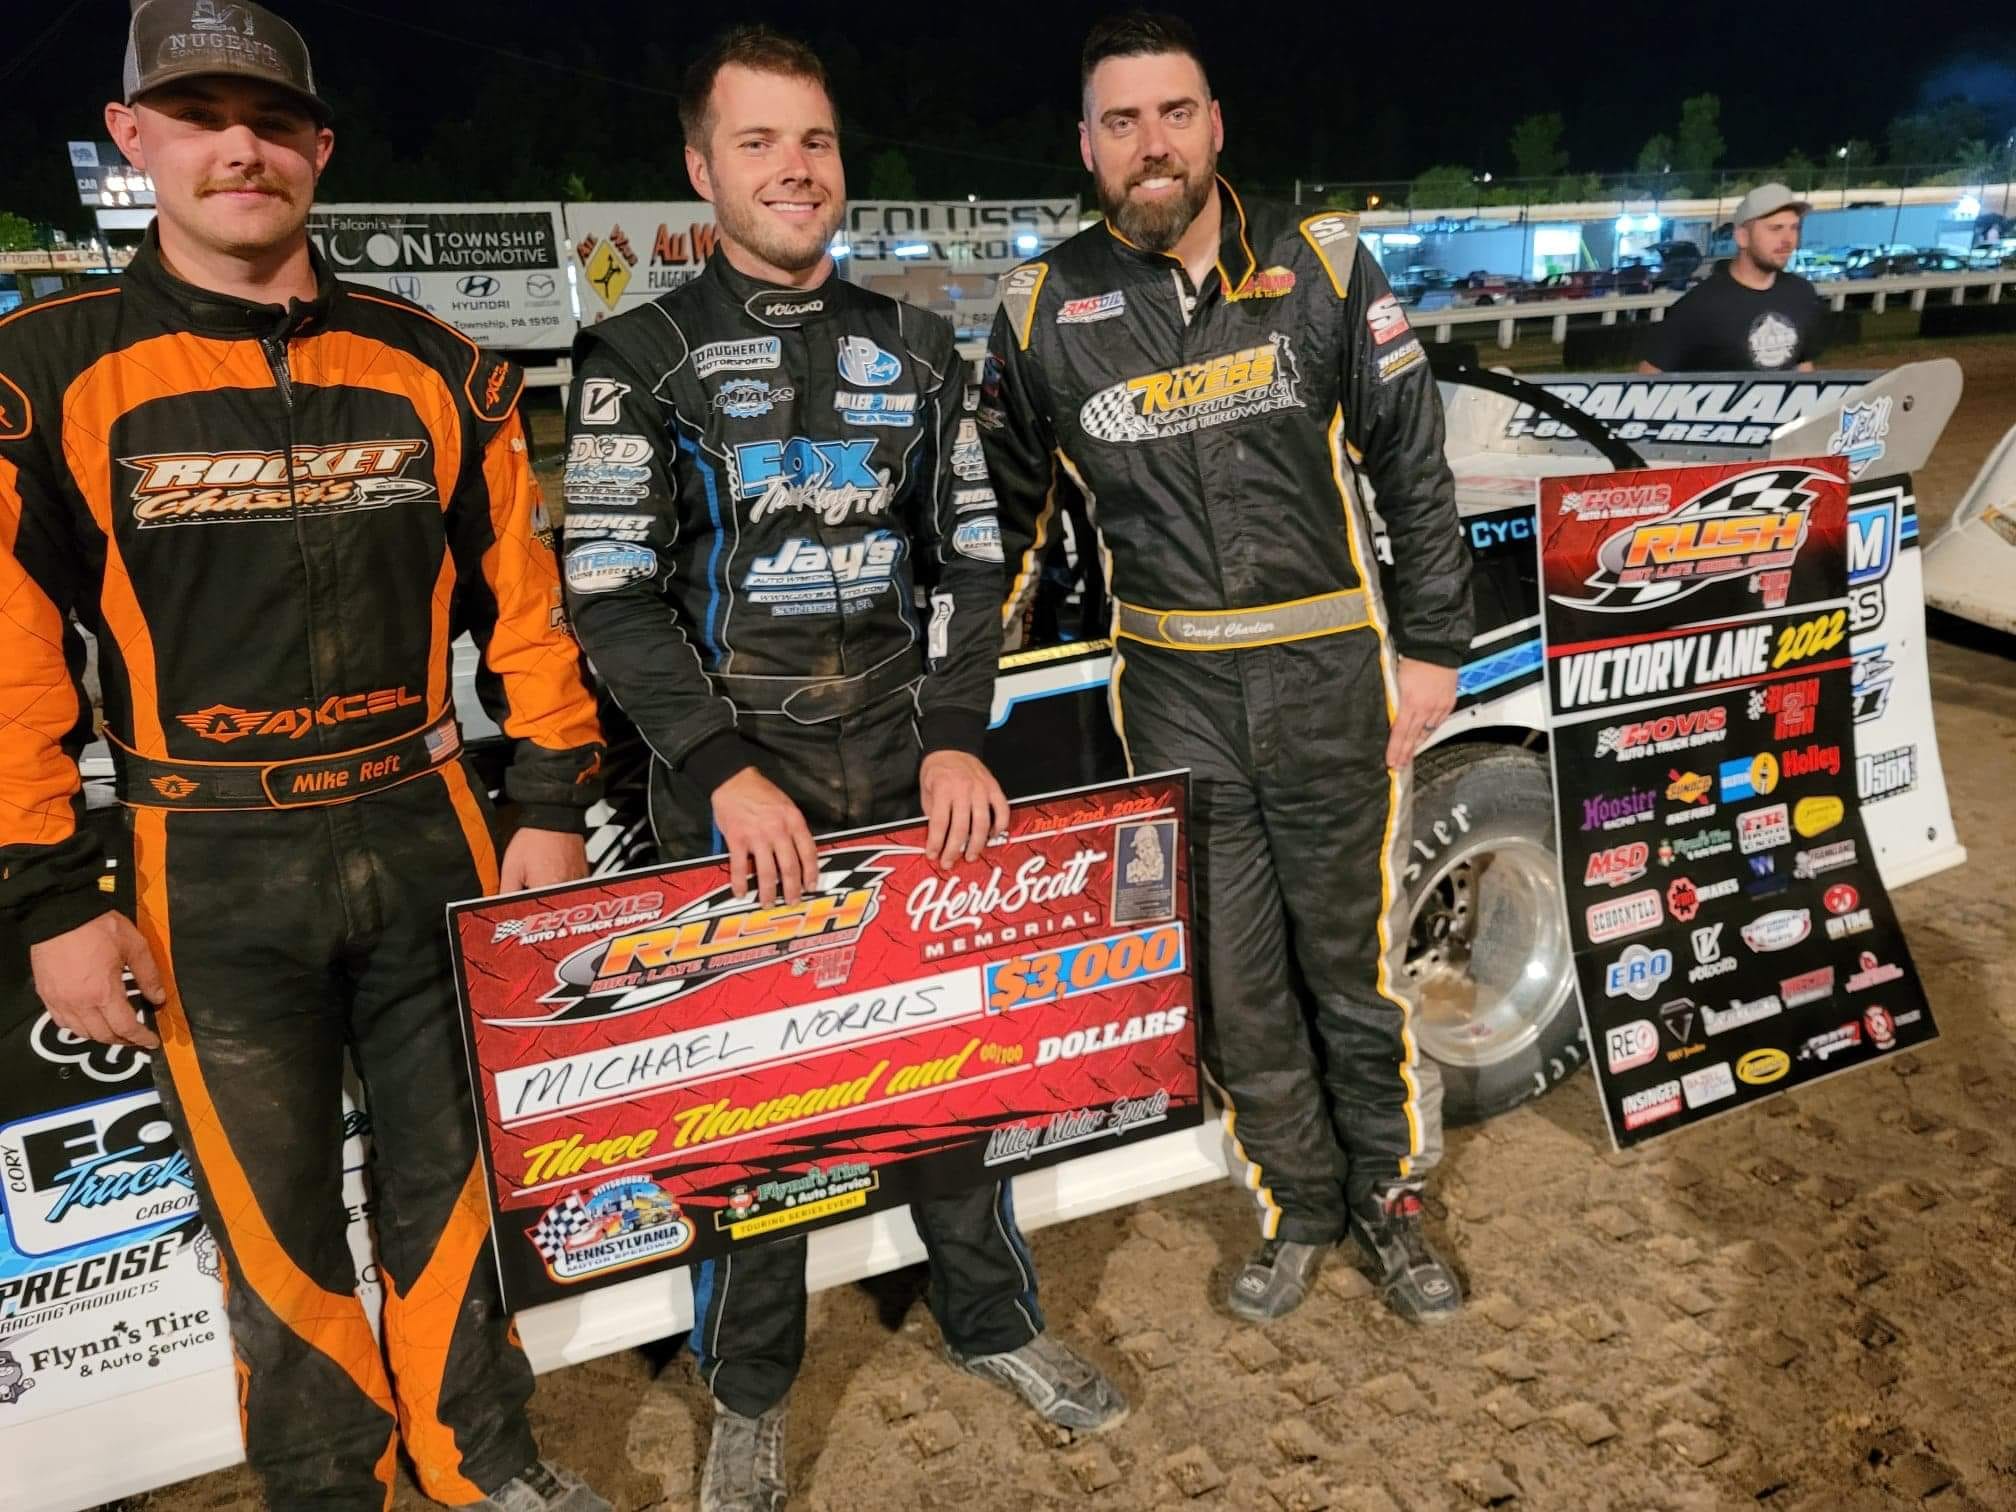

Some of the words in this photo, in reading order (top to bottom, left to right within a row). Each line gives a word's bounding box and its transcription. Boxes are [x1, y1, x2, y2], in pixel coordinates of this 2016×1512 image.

[168, 33, 278, 62] NUGENT
[78, 179, 97, 190] CAR
[434, 232, 546, 248] TOWNSHIP
[438, 249, 548, 266] AUTOMOTIVE
[452, 301, 510, 311] HYUNDAI
[511, 317, 525, 327] PA
[696, 341, 773, 364] DAUGHERTY
[698, 357, 776, 374] MOTORSPORTS
[1127, 355, 1277, 415] RIVERS
[1149, 386, 1268, 426] KARTING
[141, 441, 421, 491] ROCKET
[570, 436, 652, 464] D&D
[734, 437, 881, 499] FOX
[1583, 484, 1671, 511] HOVIS
[1471, 517, 1538, 549] CYC
[1624, 511, 1807, 569] RUSH
[752, 529, 903, 581] Jay's
[1559, 635, 1696, 709] VICTORY
[1695, 624, 1774, 683] LANE
[1772, 610, 1847, 669] 2022
[1618, 706, 1728, 749] HOVIS
[292, 769, 350, 794] Mike
[359, 754, 402, 782] Reft
[1782, 744, 1842, 778] Holley
[1580, 784, 1657, 831] Hoosier
[1587, 842, 1649, 879] MSD
[905, 866, 1003, 933] Herb
[1000, 849, 1108, 915] Scott
[519, 929, 556, 945] AUTO
[556, 928, 568, 939] &
[571, 920, 614, 935] TRUCK
[615, 909, 663, 926] SUPPLY
[524, 892, 664, 933] HOVIS
[600, 887, 877, 978] RUSH
[925, 910, 1098, 959] MEMORIAL
[647, 959, 705, 982] LATE
[989, 925, 1181, 1011] $3,000
[515, 1031, 754, 1115] MICHAEL
[780, 986, 945, 1051] NORRIS
[1035, 1006, 1188, 1067] DOLLARS
[522, 1128, 658, 1186] Three
[672, 1060, 890, 1149] Thousand
[885, 1038, 982, 1096] and
[983, 1122, 1038, 1161] Miley
[1042, 1106, 1106, 1146] Motor
[1108, 1088, 1171, 1136] Sports
[6, 1145, 28, 1194] CORY
[757, 1166, 828, 1202] Flynn's
[828, 1162, 871, 1183] Tire
[797, 1187, 828, 1204] Auto
[828, 1176, 873, 1196] Service
[740, 1214, 786, 1233] TOURING
[788, 1205, 824, 1222] SERIES
[826, 1195, 859, 1211] EVENT
[564, 1225, 680, 1265] PENNSYLVANIA
[0, 1237, 178, 1312] PRECISE
[0, 1305, 65, 1335] RACING
[69, 1279, 161, 1316] PRODUCTS
[29, 1321, 142, 1373] Flynn's
[145, 1309, 210, 1338] Tire
[79, 1363, 92, 1378] &
[100, 1351, 143, 1372] Auto
[148, 1330, 215, 1358] Service
